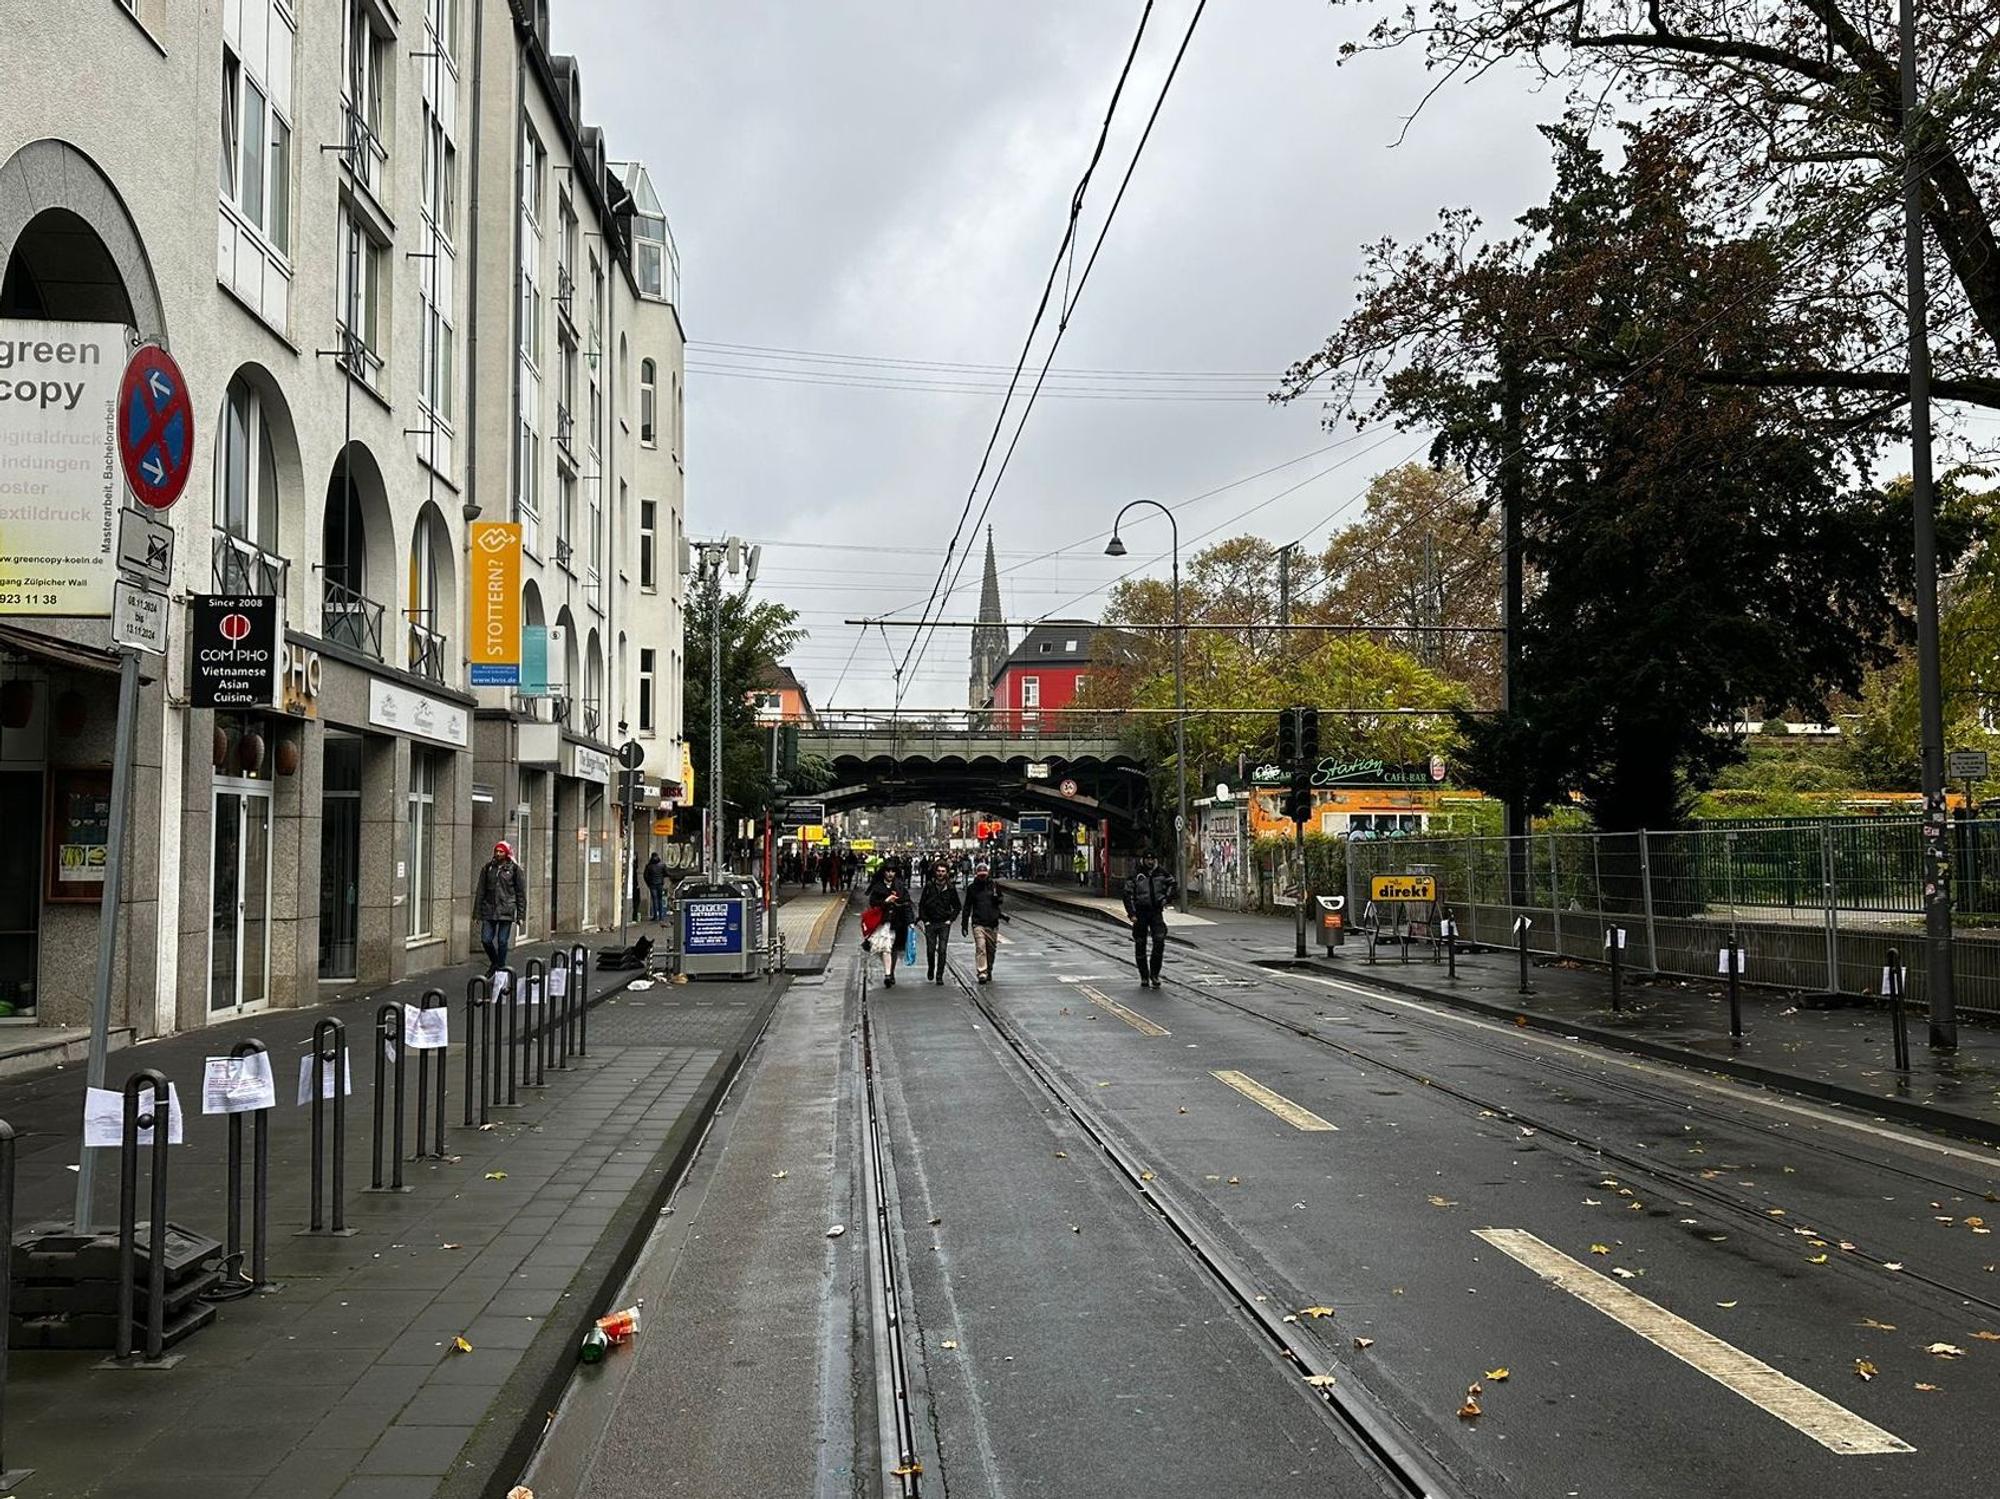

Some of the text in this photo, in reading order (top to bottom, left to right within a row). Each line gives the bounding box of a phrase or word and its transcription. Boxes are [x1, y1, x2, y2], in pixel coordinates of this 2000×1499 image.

[0, 341, 100, 368] green
[0, 380, 85, 410] copy
[0, 430, 102, 447] igitaldruck
[103, 400, 115, 480] Bachelorarbeit
[68, 578, 87, 587] Wall
[0, 594, 57, 605] 923 11 38
[208, 598, 263, 607] Since 2008
[487, 560, 504, 656] STOTTERN?
[200, 650, 268, 661] COM PHO
[202, 666, 266, 676] Vietnamese
[218, 680, 249, 689] Asian
[213, 692, 253, 702] Cuisine
[1310, 757, 1384, 786] Station
[1379, 885, 1429, 898] direkt
